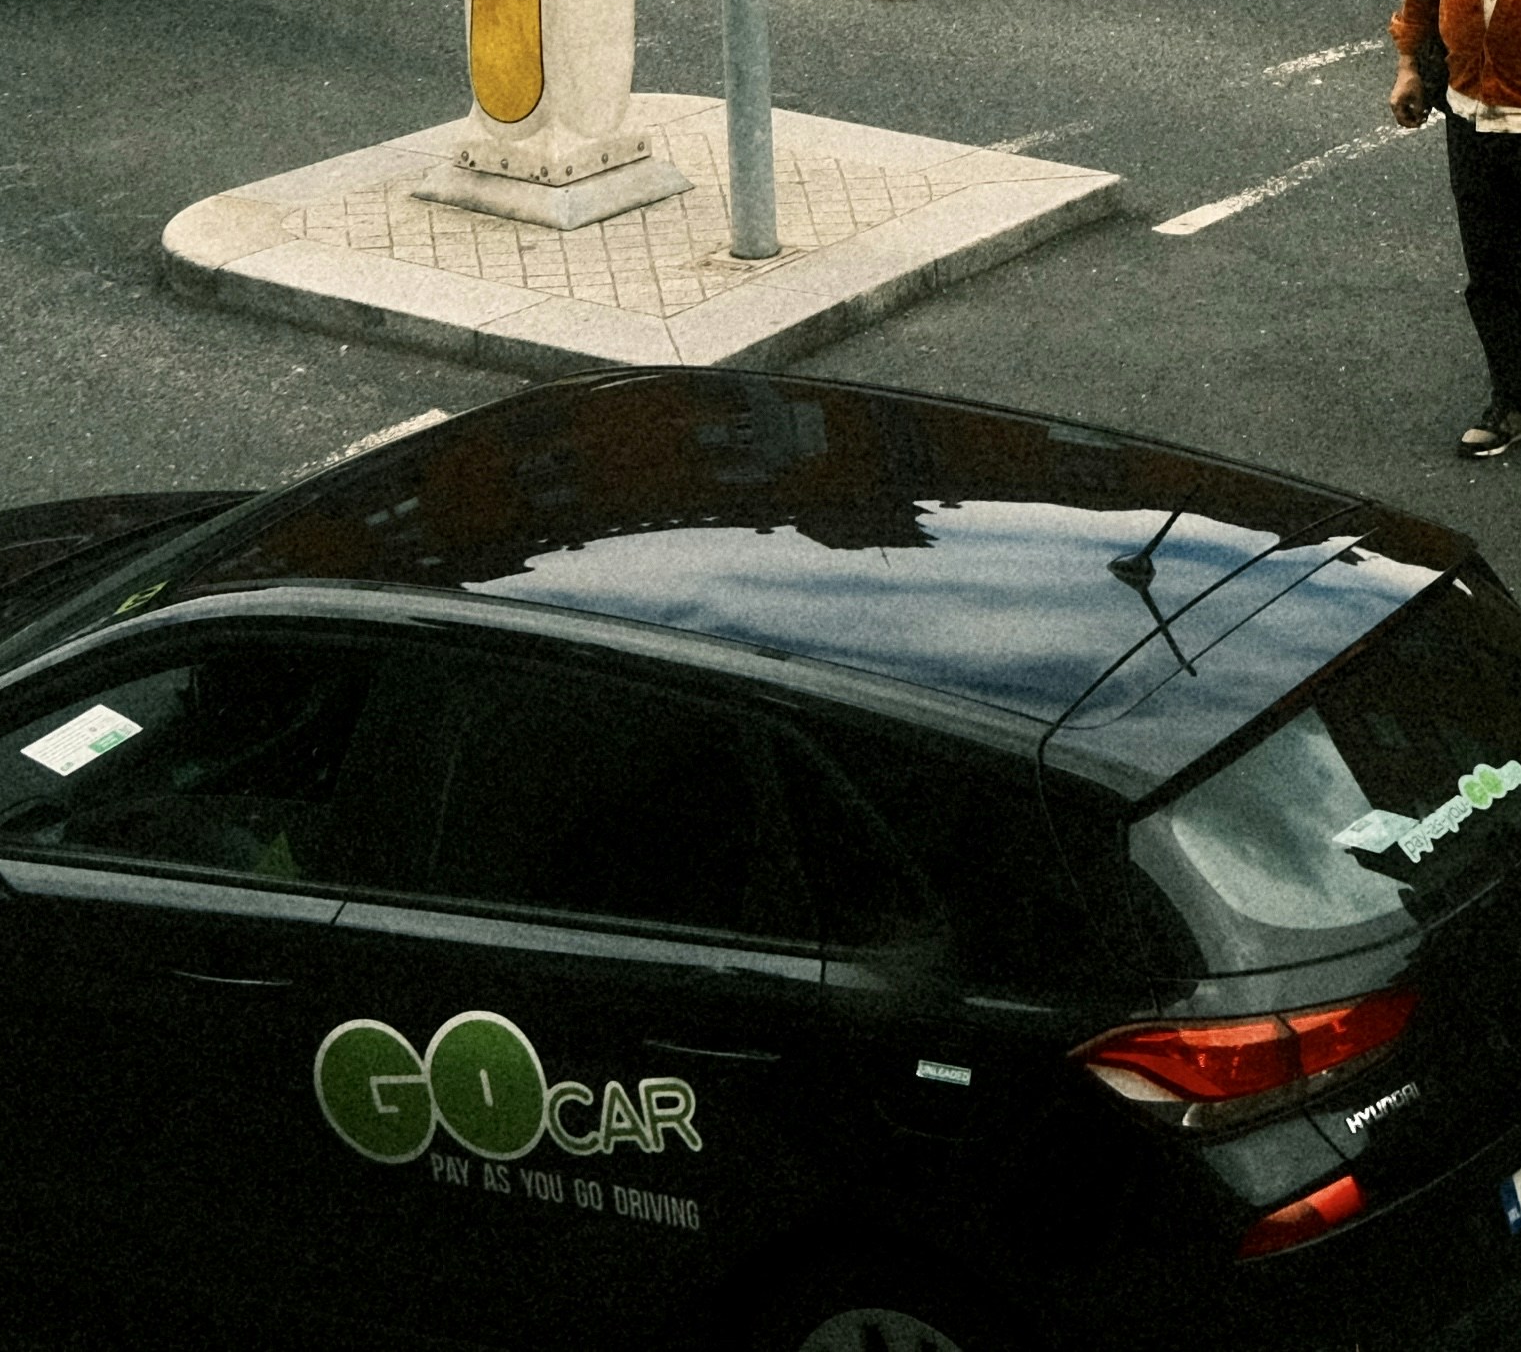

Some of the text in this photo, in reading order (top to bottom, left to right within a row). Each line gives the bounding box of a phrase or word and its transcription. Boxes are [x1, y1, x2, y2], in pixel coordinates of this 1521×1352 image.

[1345, 1081, 1421, 1134] HYUNDAI
[428, 1152, 701, 1231] PAY AS YOU GO DRIVING
